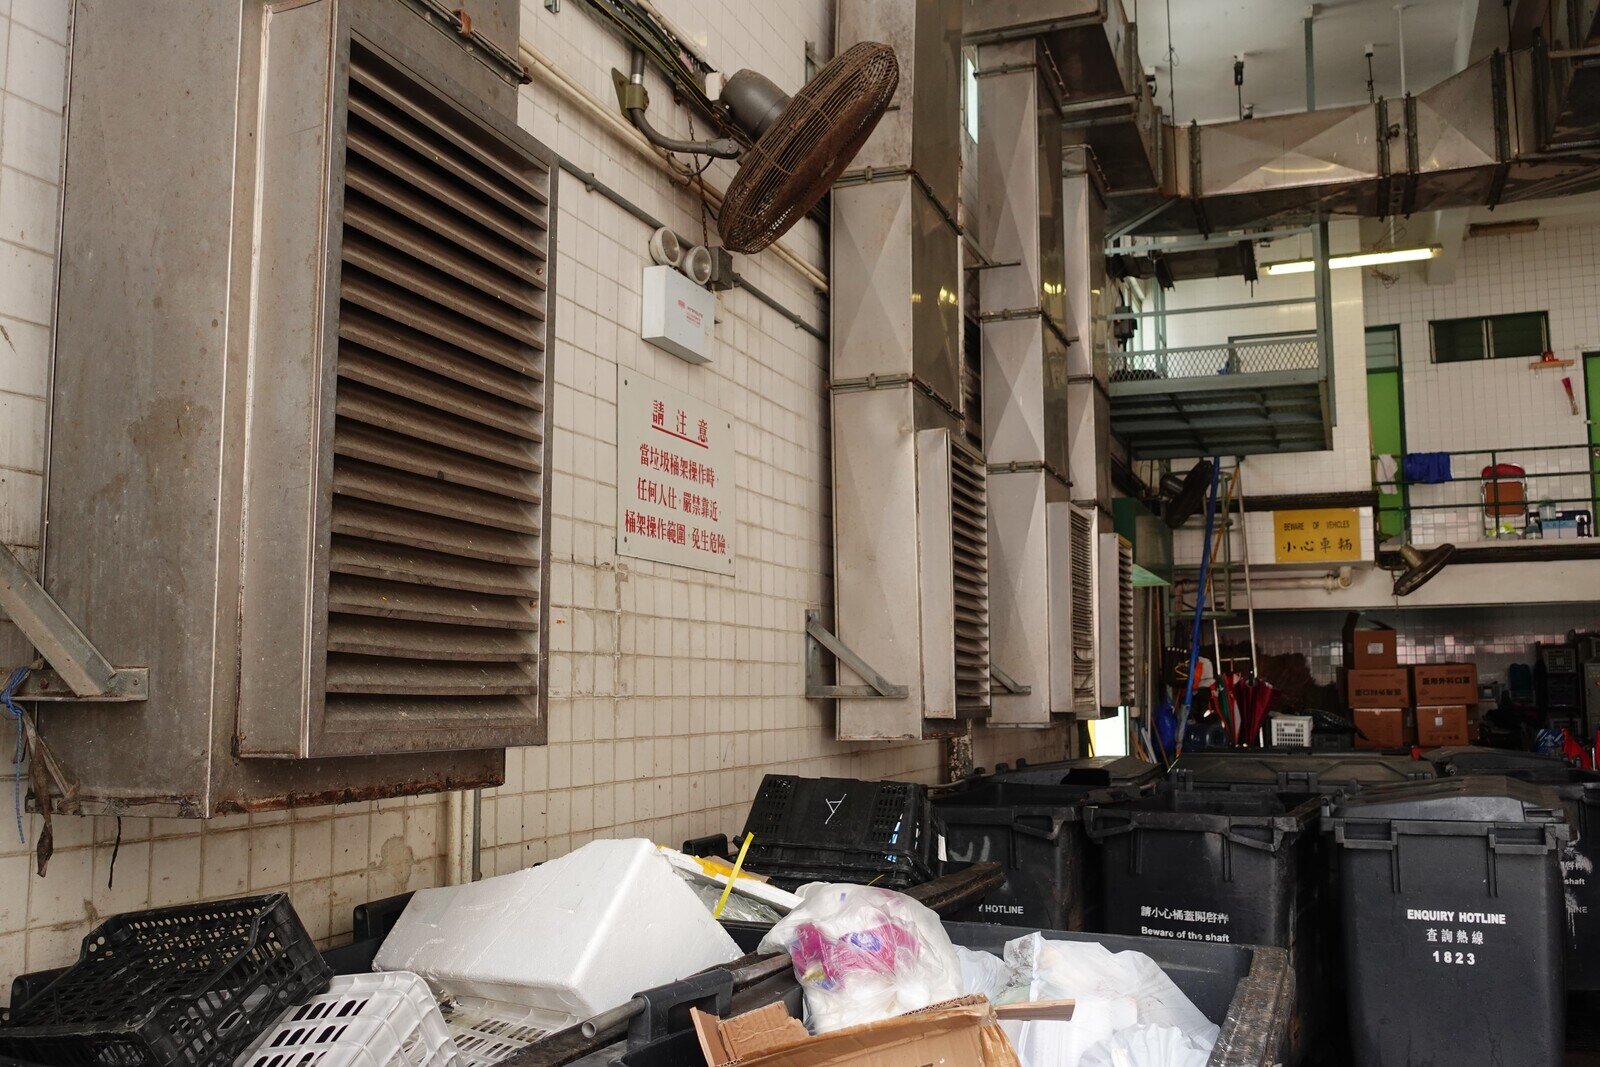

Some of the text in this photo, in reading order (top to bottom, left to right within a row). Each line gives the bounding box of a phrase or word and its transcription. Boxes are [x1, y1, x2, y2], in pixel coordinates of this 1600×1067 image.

[652, 400, 708, 443] 請注意
[1284, 520, 1350, 531] BEWARE OF VEHICLES
[1283, 537, 1352, 553] 小心車輛
[985, 904, 1024, 914] HOTLINE
[1407, 909, 1506, 924] ENQUIRY HOTLINE
[1141, 926, 1230, 942] Beware of the shaft
[1426, 927, 1484, 945] 查詢熱線
[1432, 950, 1476, 965] 1823
